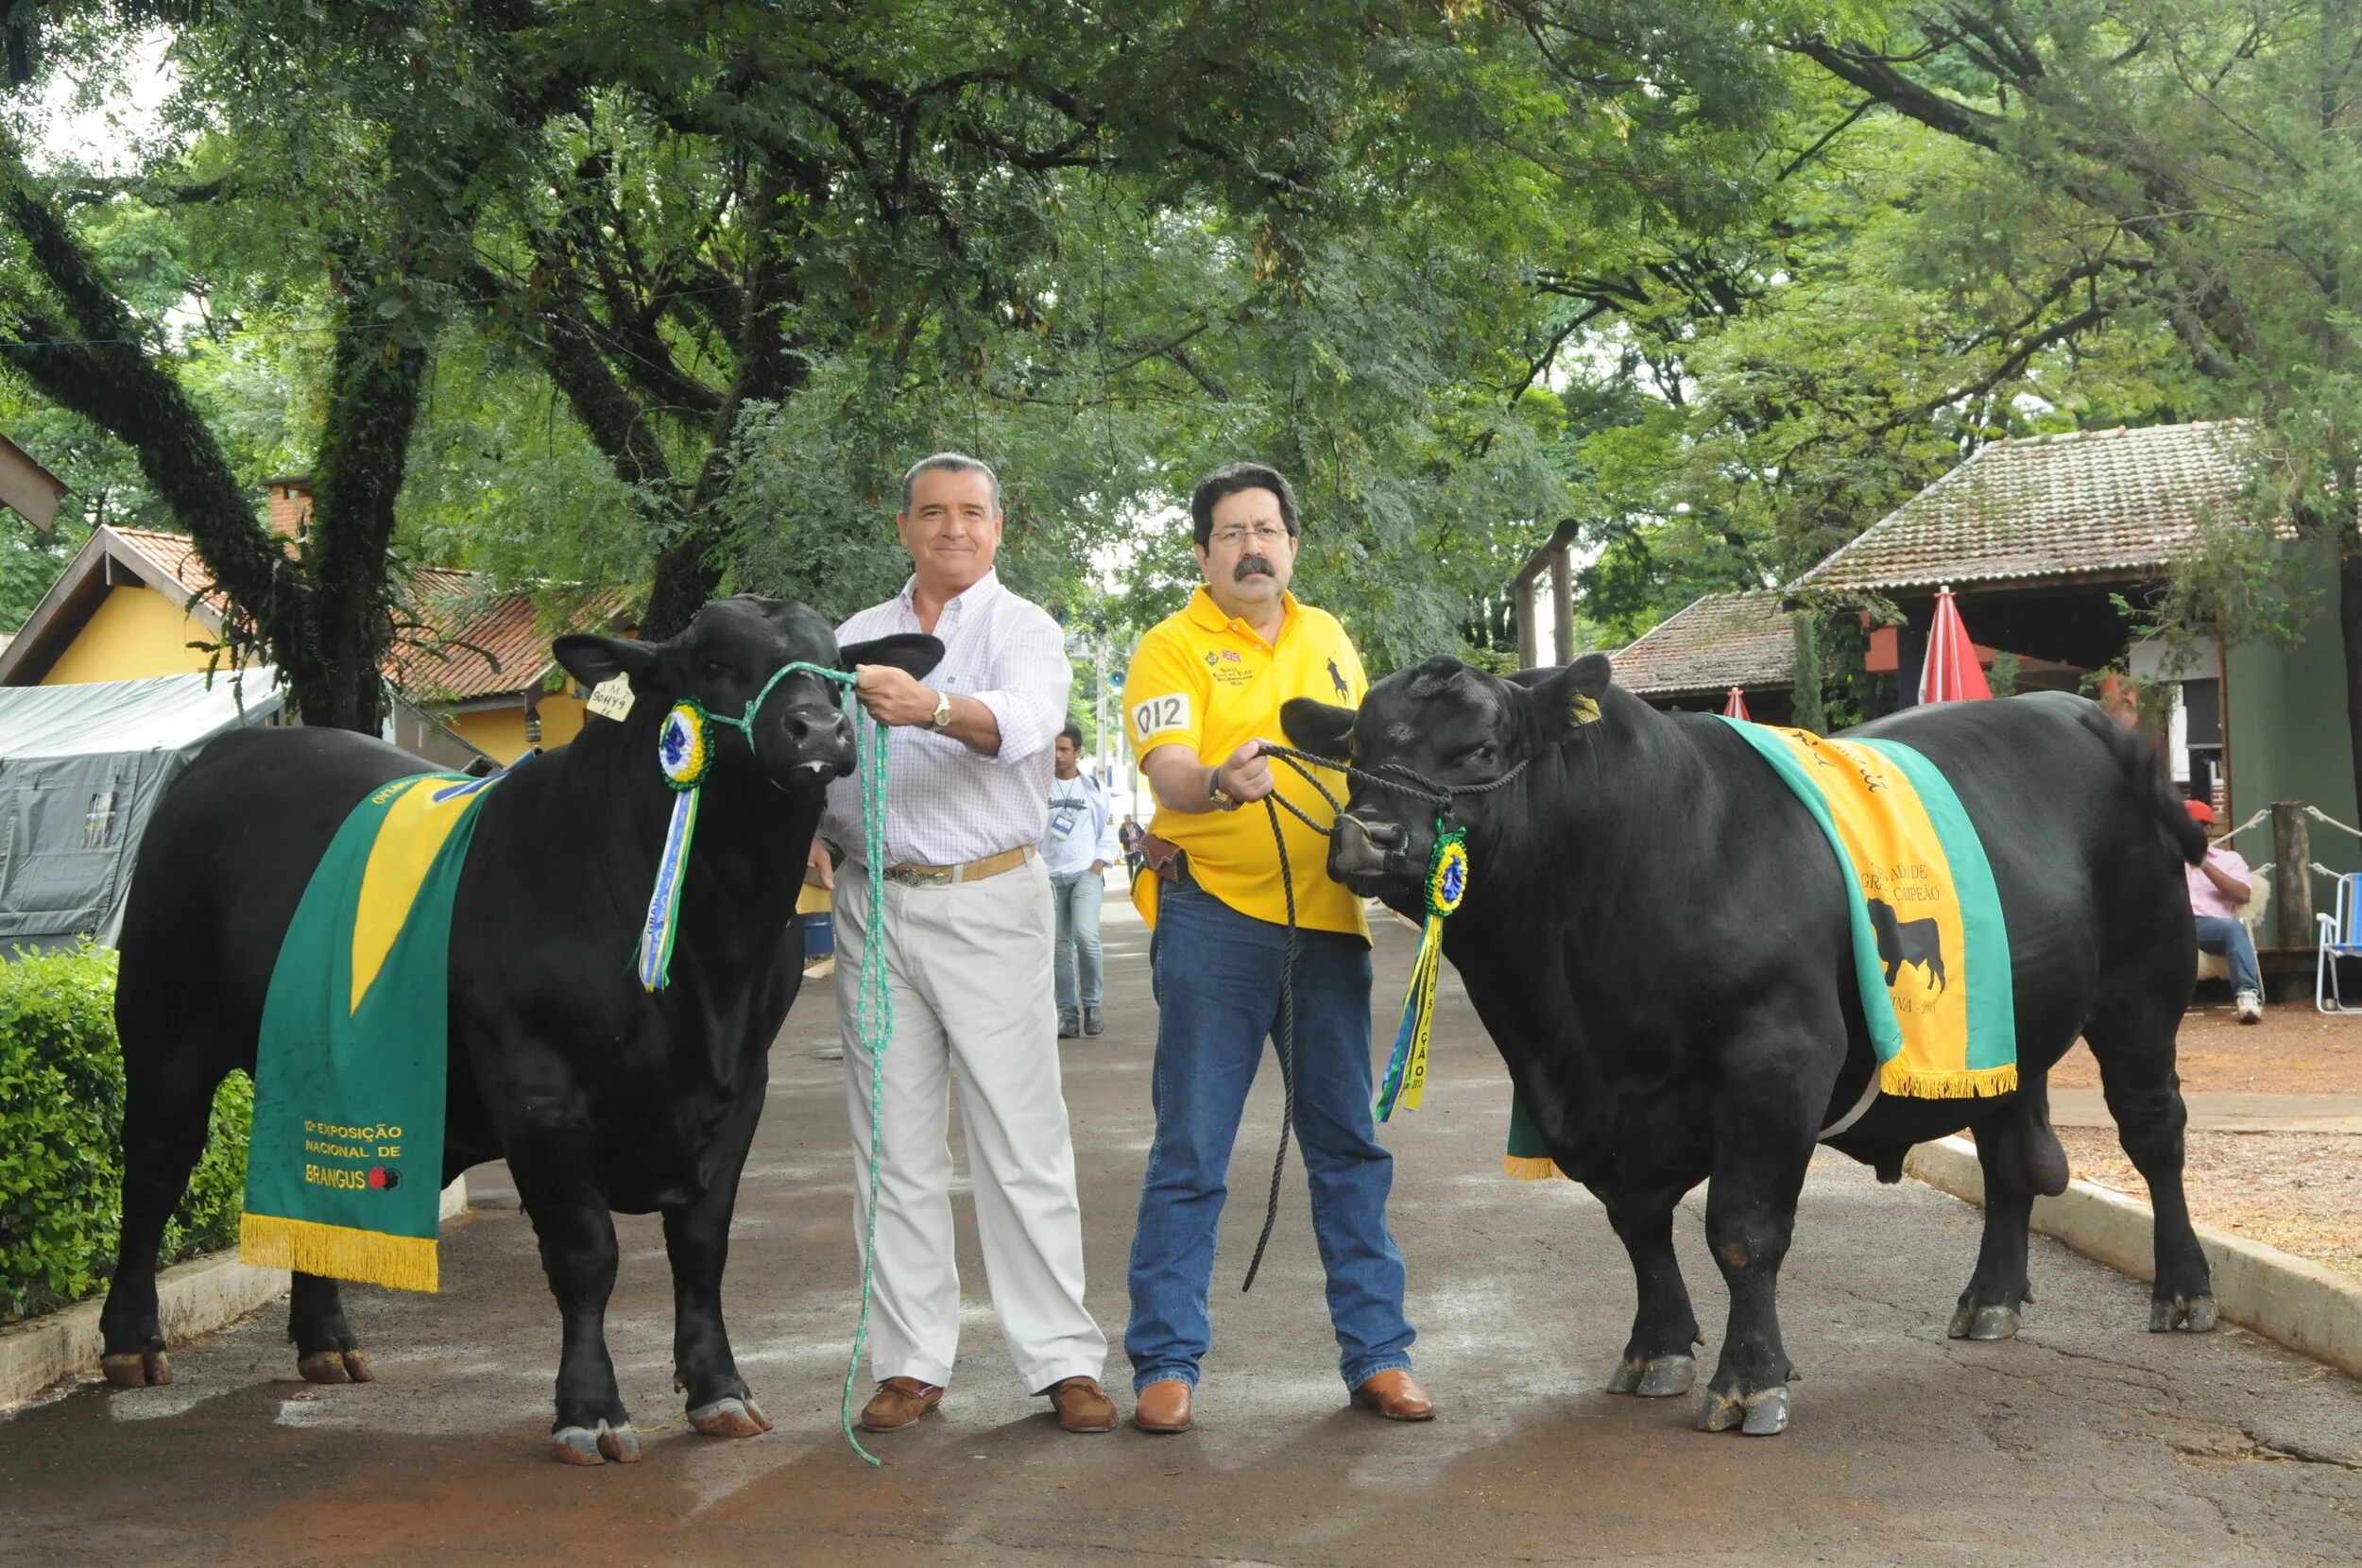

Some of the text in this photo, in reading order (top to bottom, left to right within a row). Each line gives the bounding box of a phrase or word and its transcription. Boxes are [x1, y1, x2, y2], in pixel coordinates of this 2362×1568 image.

[1137, 697, 1183, 735] 012
[1416, 930, 1441, 1077] EXPOSIÇÃO
[317, 1123, 402, 1142] EXPOSIÇÃO
[305, 1139, 401, 1158] NACIONAL DE
[305, 1164, 366, 1189] BRANGUS
